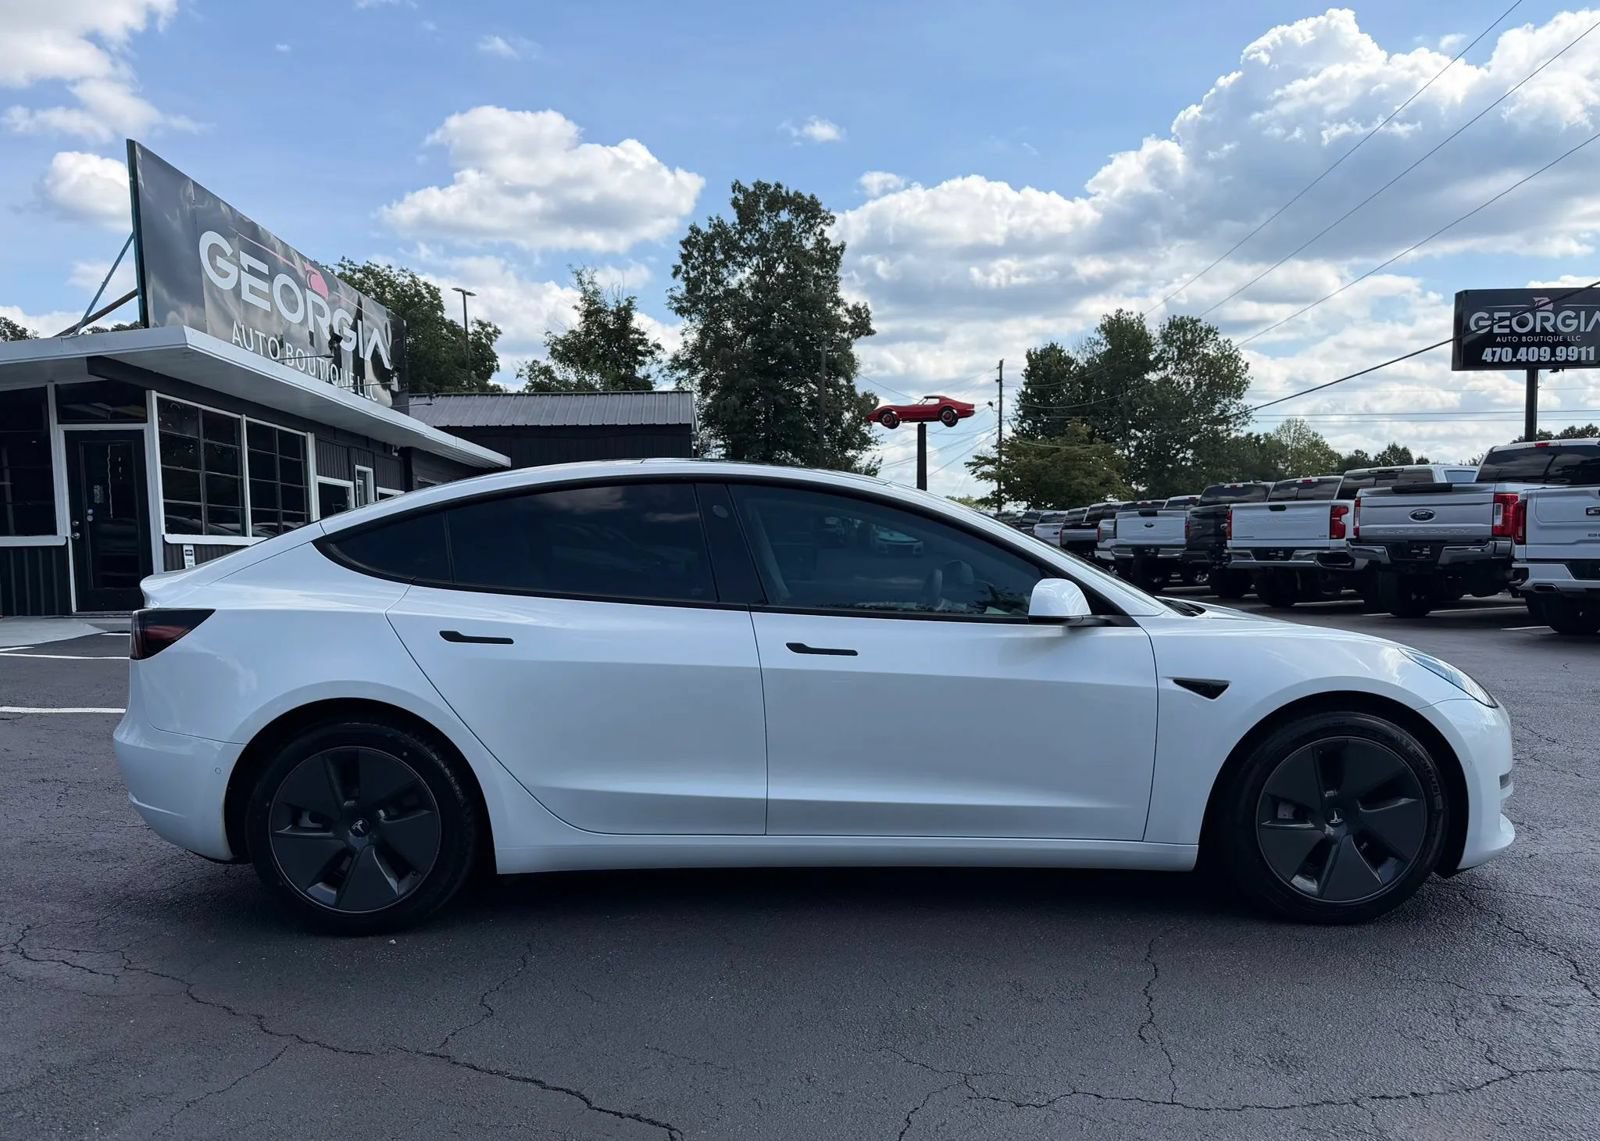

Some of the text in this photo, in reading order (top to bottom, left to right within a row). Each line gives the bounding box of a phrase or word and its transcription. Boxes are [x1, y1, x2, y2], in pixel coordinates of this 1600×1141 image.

[198, 230, 393, 370] GEORGIA
[232, 320, 378, 402] AUTO BOUTIQUE LLC
[1481, 345, 1595, 363] 470.409.9911
[1495, 335, 1518, 343] AUTO
[1521, 335, 1564, 343] BOUTIQUE
